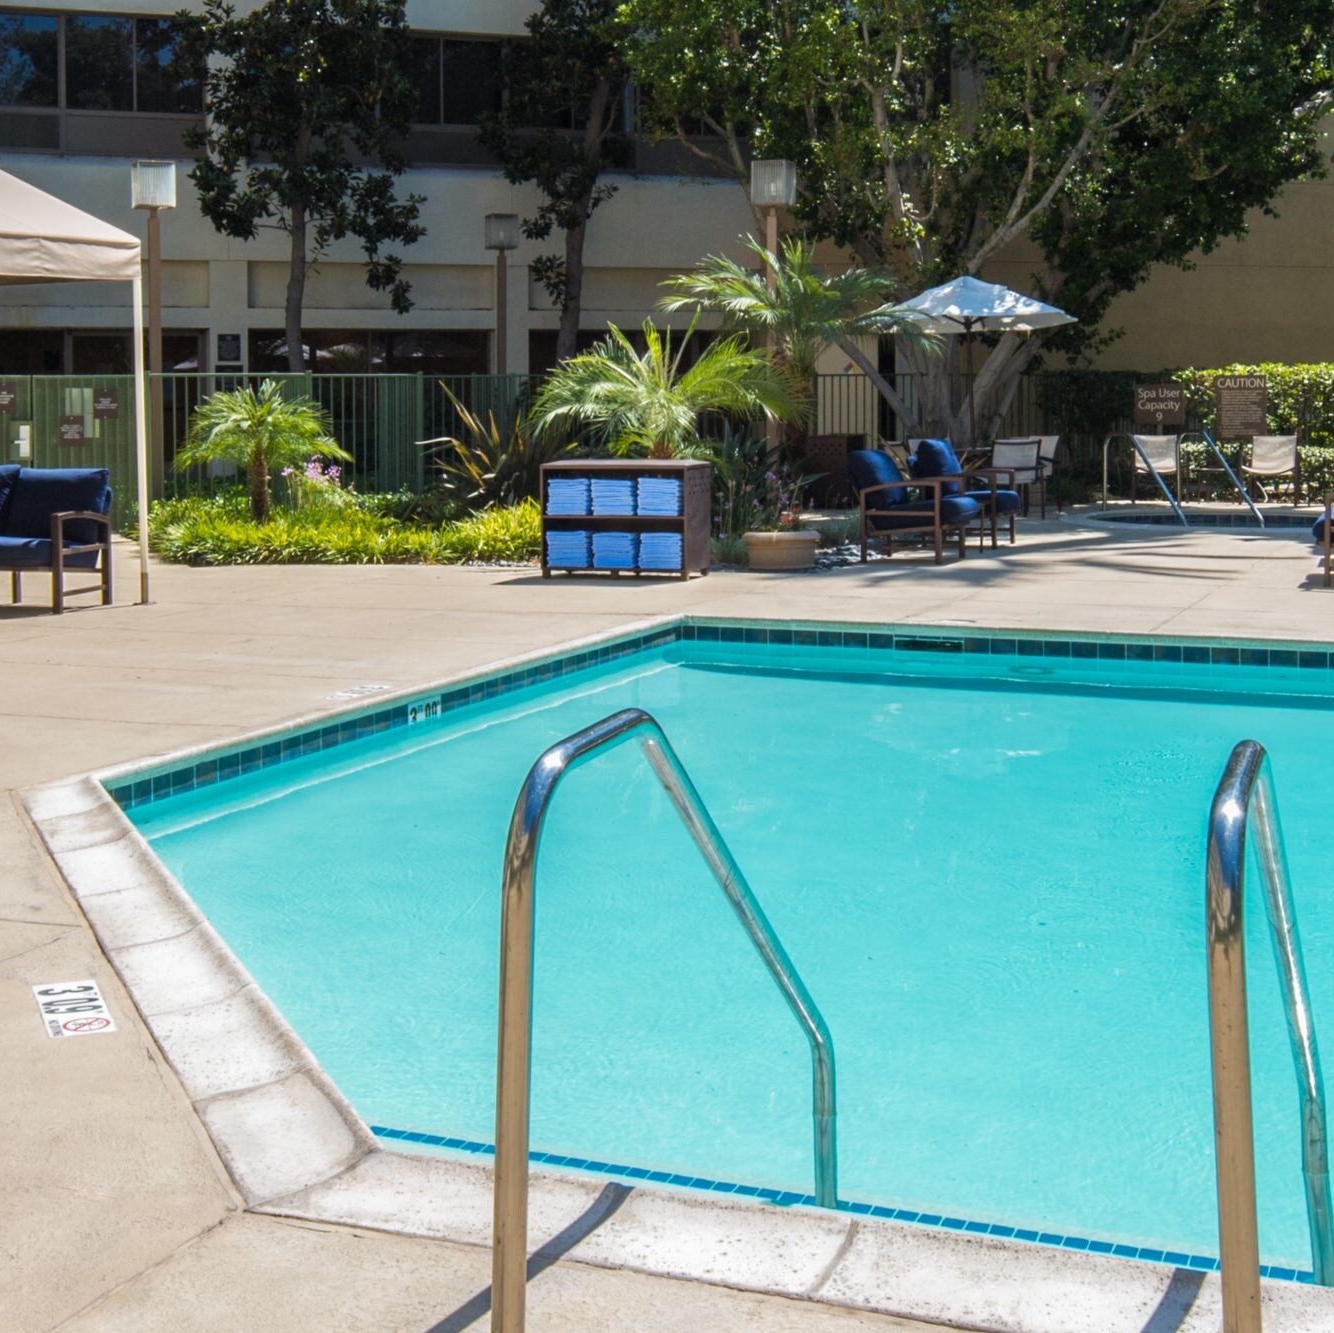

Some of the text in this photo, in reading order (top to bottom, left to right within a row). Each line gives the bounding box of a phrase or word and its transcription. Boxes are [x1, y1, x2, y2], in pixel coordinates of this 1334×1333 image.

[1217, 378, 1265, 388] CAUTION
[1138, 388, 1180, 400] Spa User
[1138, 400, 1181, 411] Capacity
[1155, 411, 1163, 421] 9
